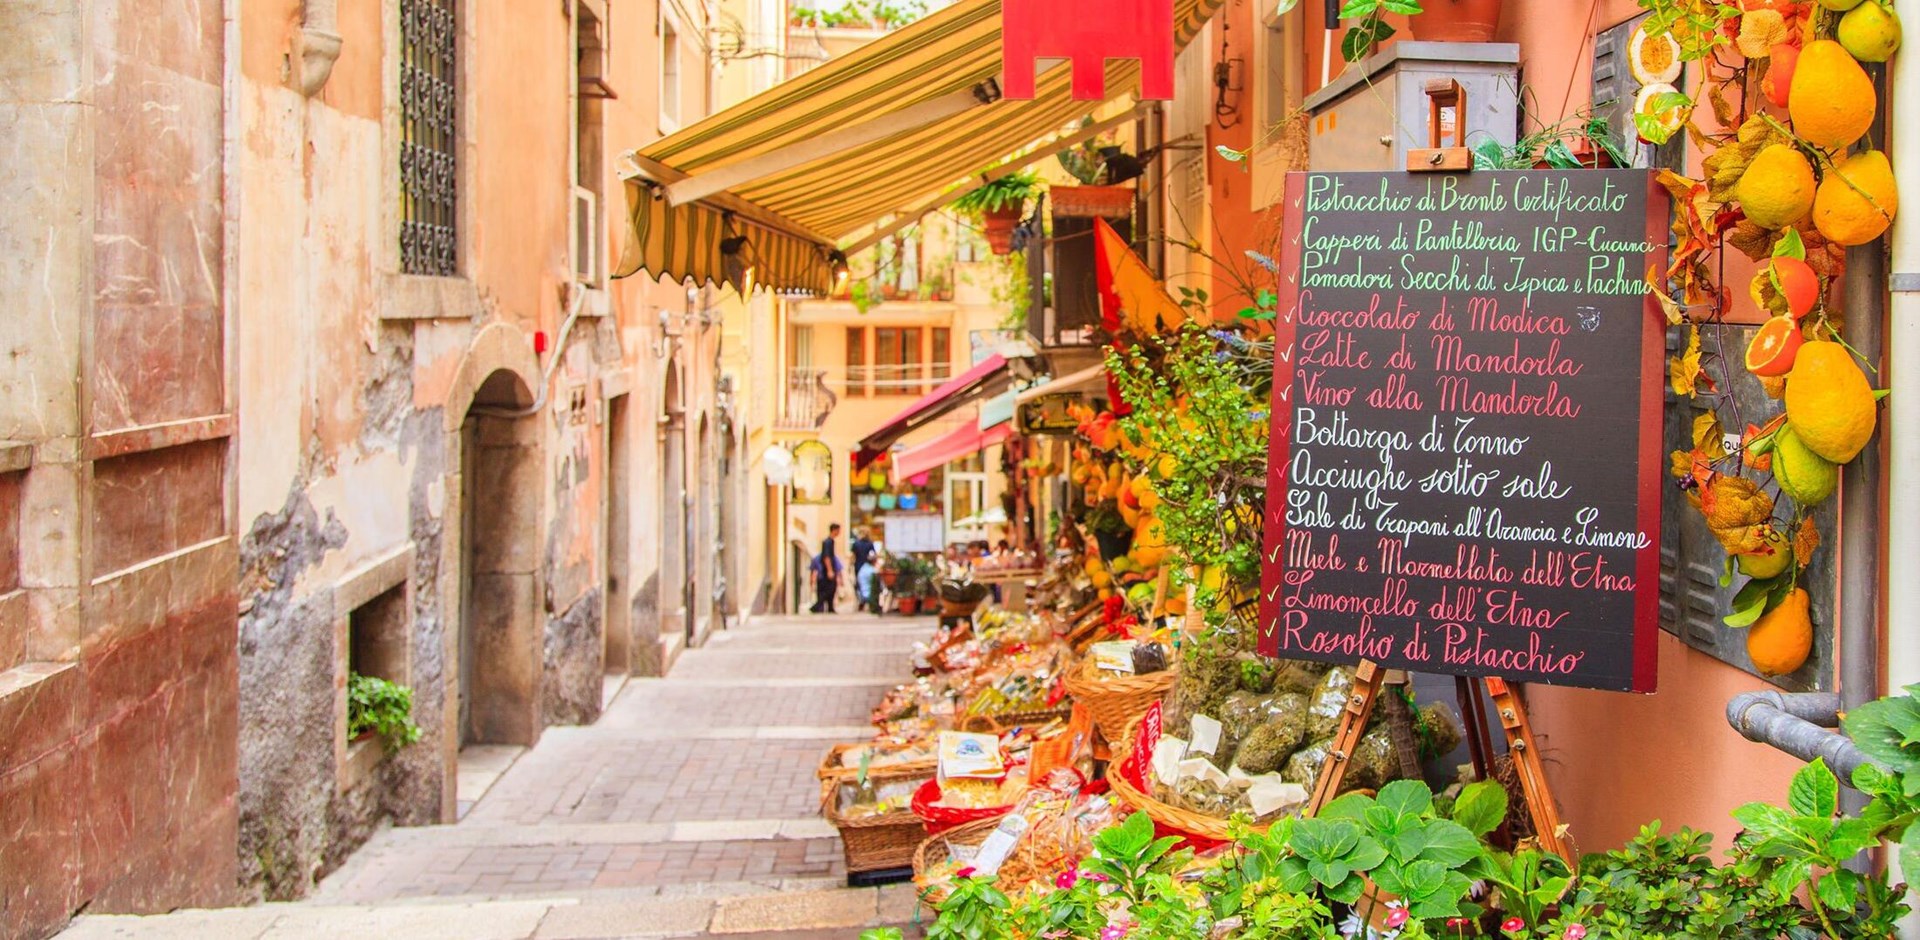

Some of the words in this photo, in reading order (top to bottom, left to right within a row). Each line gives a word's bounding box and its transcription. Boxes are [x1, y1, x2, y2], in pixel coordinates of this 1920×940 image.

[1307, 175, 1413, 212] Pistacchio
[1415, 177, 1436, 211] di
[1440, 176, 1507, 212] Bronte
[1514, 176, 1628, 222] Certificato
[1303, 216, 1383, 265] Capperi
[1388, 222, 1409, 251] di
[1415, 218, 1521, 252] Pantelleria
[1302, 251, 1394, 289] Pomodori
[1400, 253, 1471, 291] Secchi
[1474, 256, 1497, 292] di
[1572, 278, 1583, 293] e
[1298, 289, 1420, 329] Cioccolato
[1428, 296, 1455, 331] di
[1467, 297, 1571, 335] Modica
[1299, 329, 1372, 369] Latte
[1384, 333, 1416, 370] di
[1431, 335, 1584, 376] Mandorla
[1297, 369, 1357, 406] Vino
[1365, 373, 1423, 410] alla
[1436, 376, 1581, 418] Mandorla
[1296, 407, 1412, 463] Bottarga
[1418, 415, 1445, 451] di
[1453, 416, 1530, 455] Tonno
[1292, 449, 1413, 510] Acciughe
[1418, 457, 1500, 497] sotto
[1503, 460, 1573, 499] sale
[1286, 489, 1336, 527] Sale
[1339, 498, 1365, 529] di
[1375, 498, 1450, 548] Trapani
[1561, 527, 1572, 544] e
[1575, 507, 1652, 549] Limone
[1287, 529, 1347, 570] Miele
[1355, 556, 1369, 572] e
[1378, 537, 1514, 583] Marmellata
[1284, 570, 1419, 617] Limoncello
[1283, 610, 1394, 659] Rosolio
[1402, 622, 1430, 661] di
[1434, 622, 1585, 673] Pistacchio
